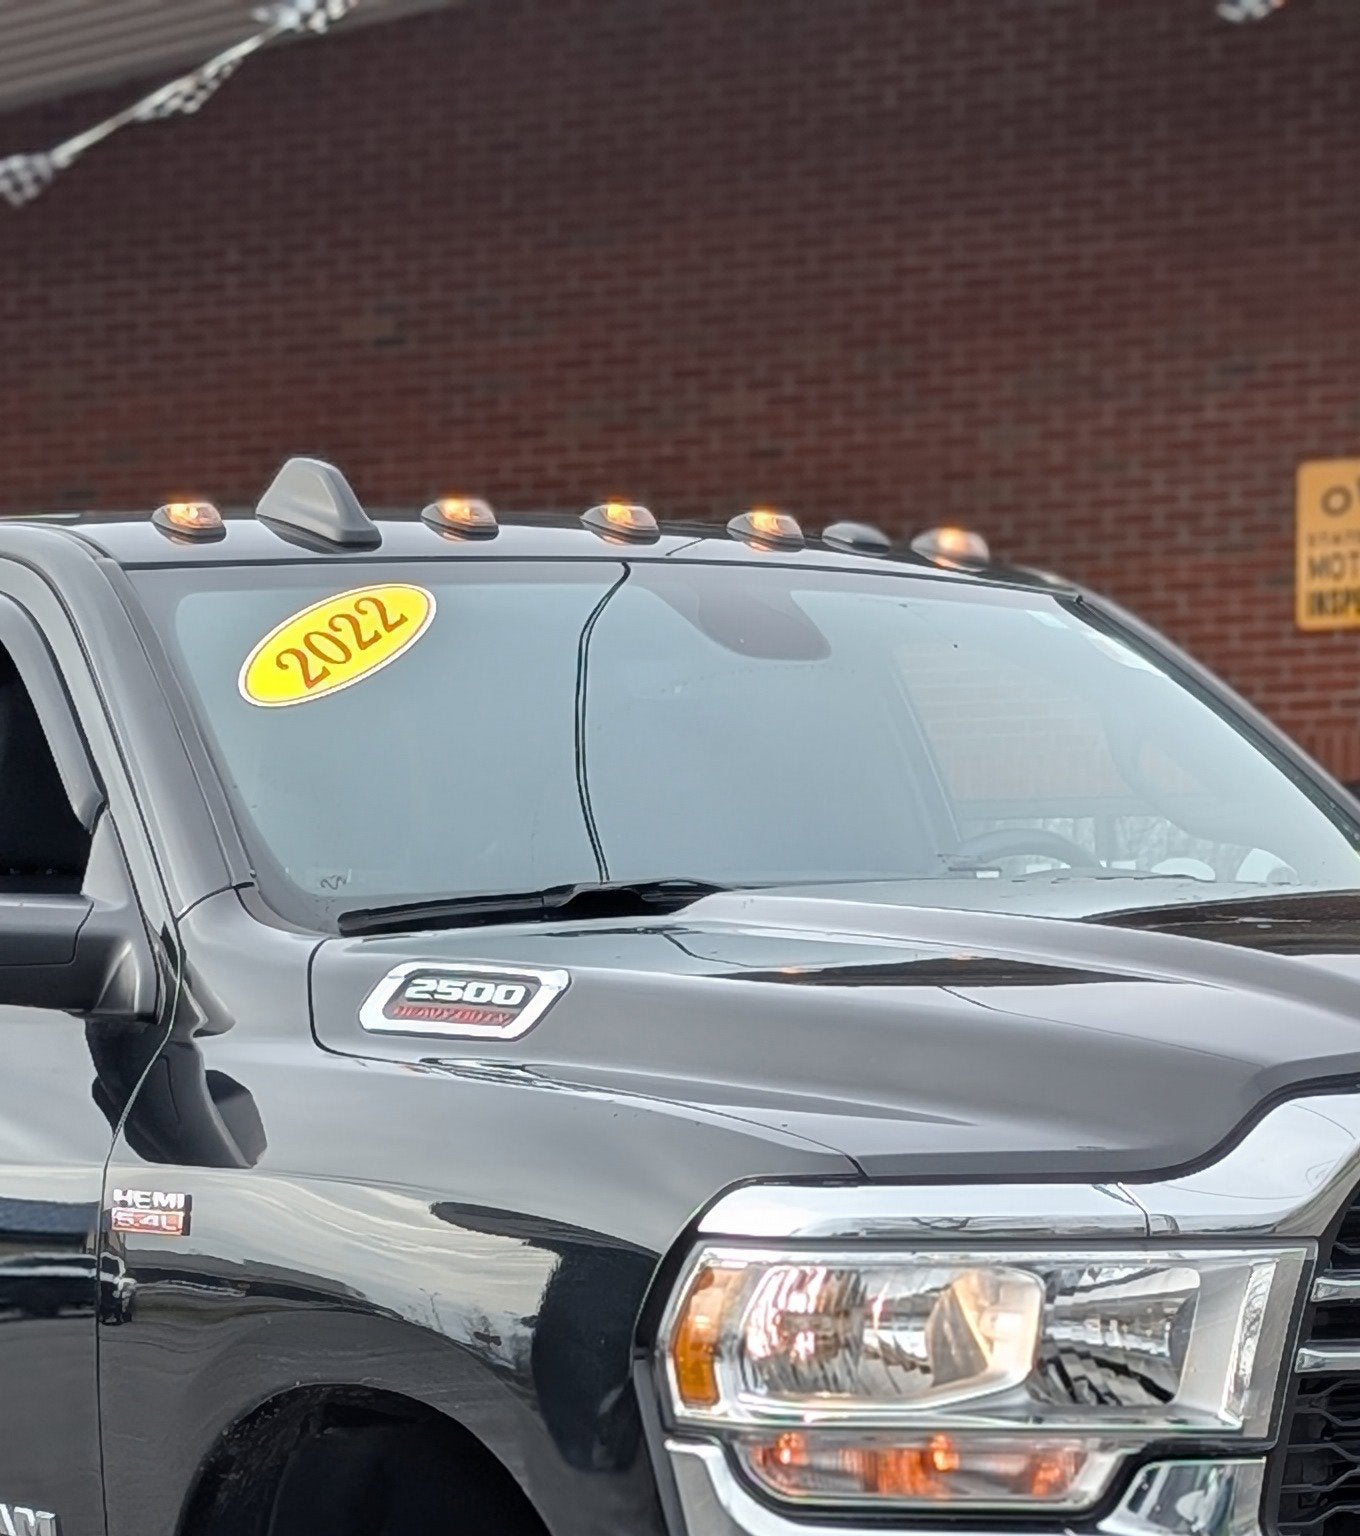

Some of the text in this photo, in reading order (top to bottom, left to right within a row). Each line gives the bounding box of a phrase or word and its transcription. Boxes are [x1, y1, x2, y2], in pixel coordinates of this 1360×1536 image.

[276, 597, 408, 690] 2022
[404, 978, 527, 1006] 2500
[113, 1188, 185, 1209] HEMI
